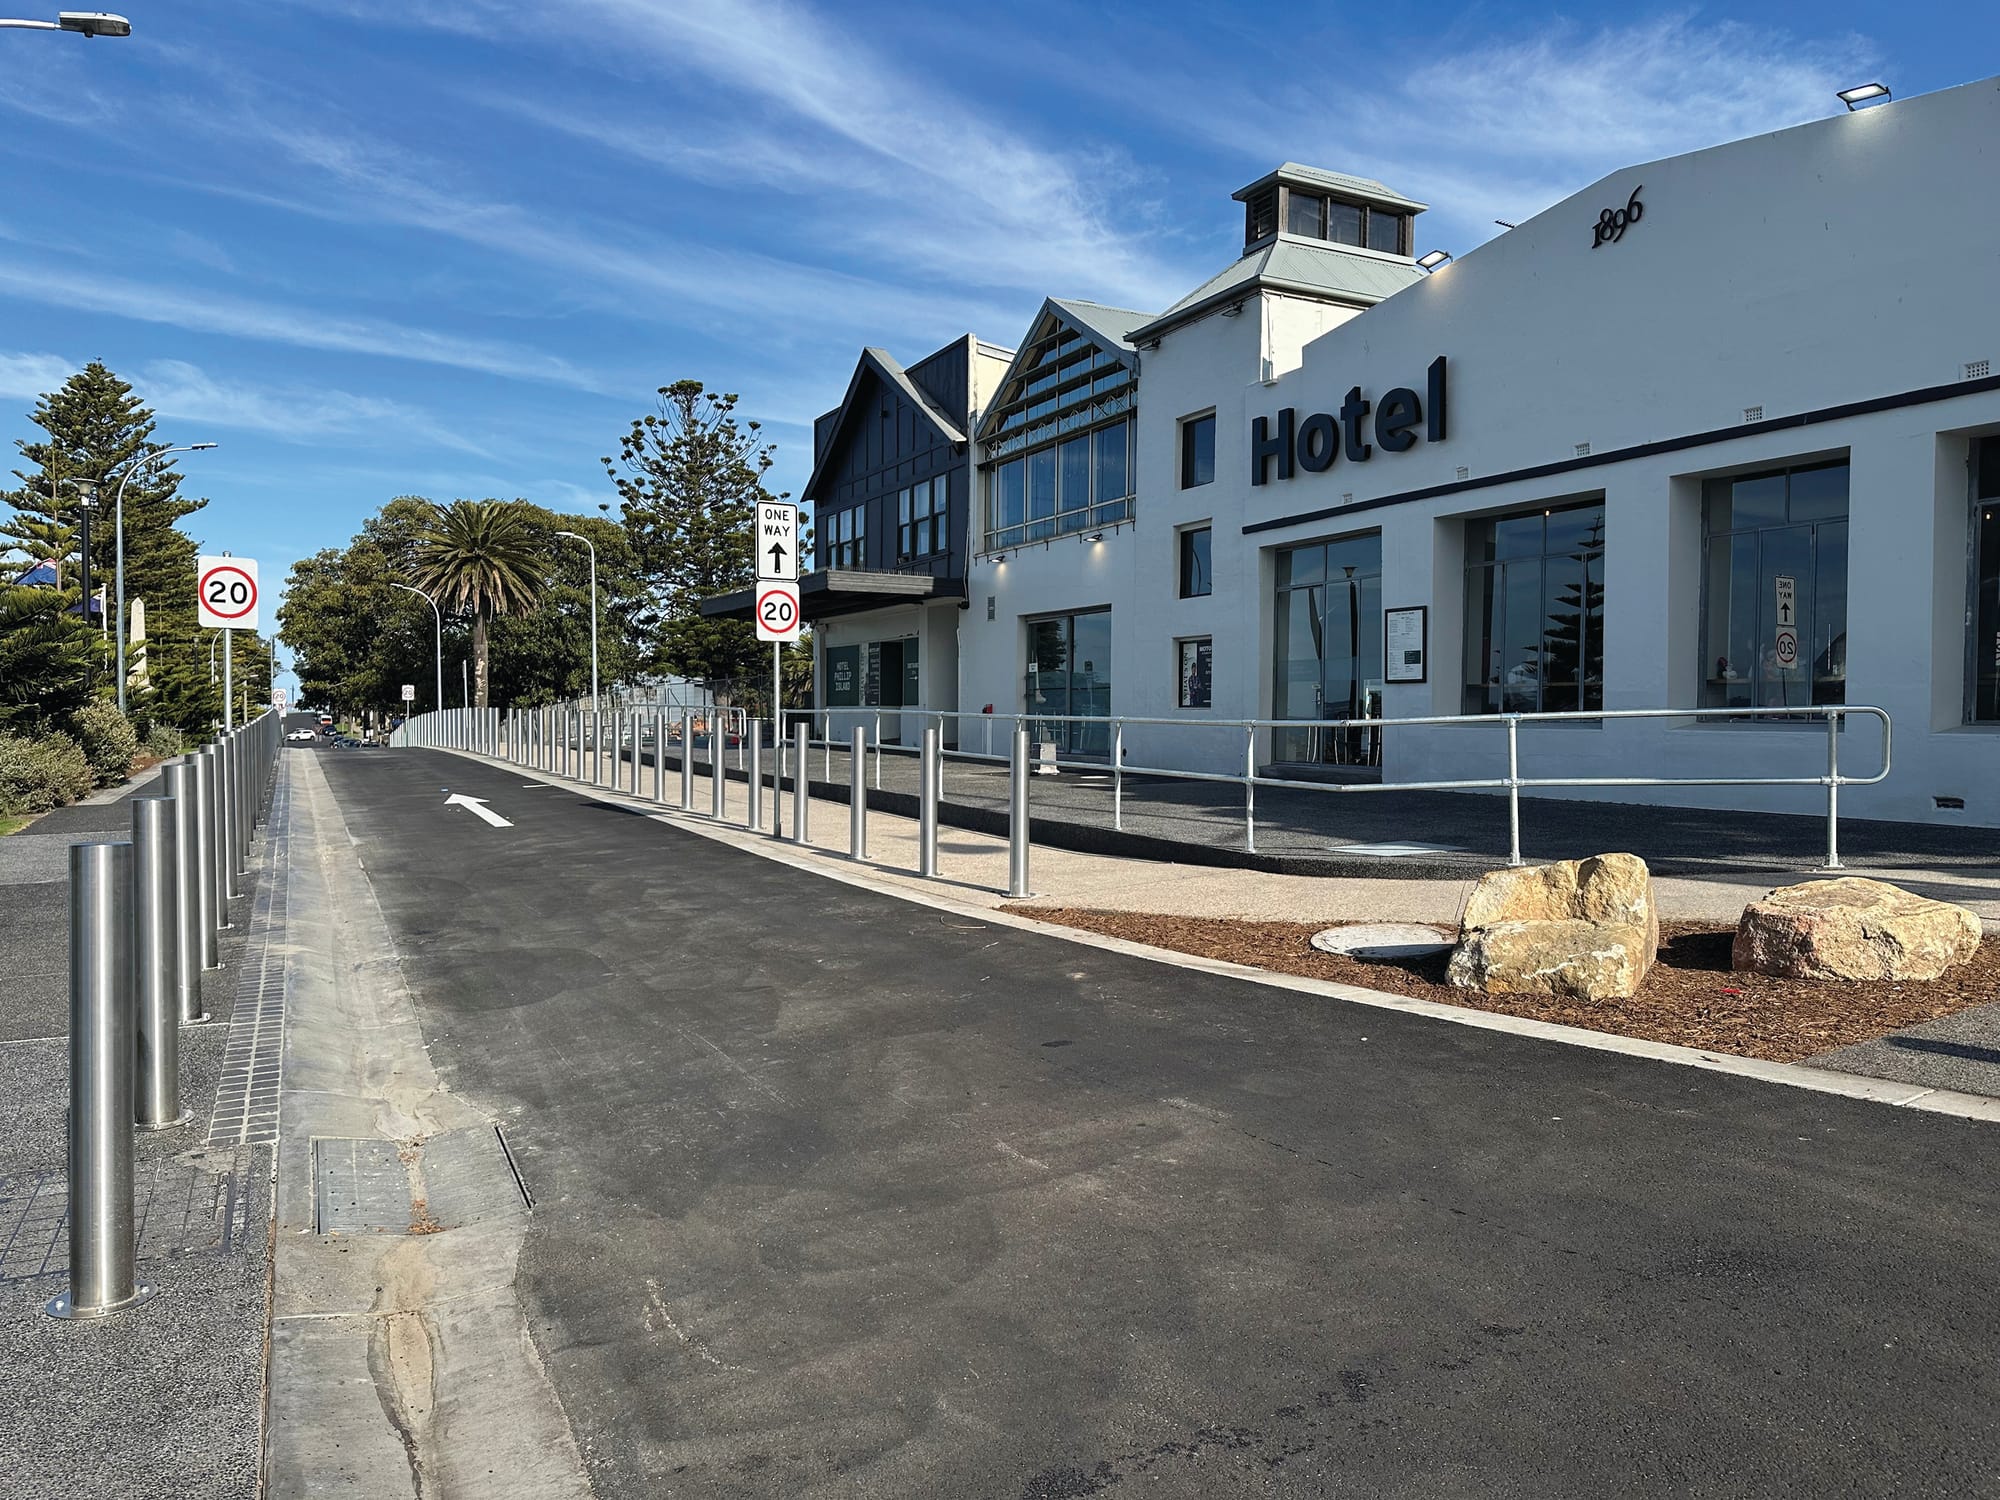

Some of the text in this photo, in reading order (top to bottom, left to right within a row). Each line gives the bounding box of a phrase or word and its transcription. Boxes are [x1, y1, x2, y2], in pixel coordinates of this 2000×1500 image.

[1592, 185, 1643, 249] 1896
[1252, 356, 1447, 486] Hotel
[765, 508, 789, 521] ONE
[764, 525, 790, 537] WAY
[209, 580, 247, 604] 20
[764, 602, 792, 621] 20
